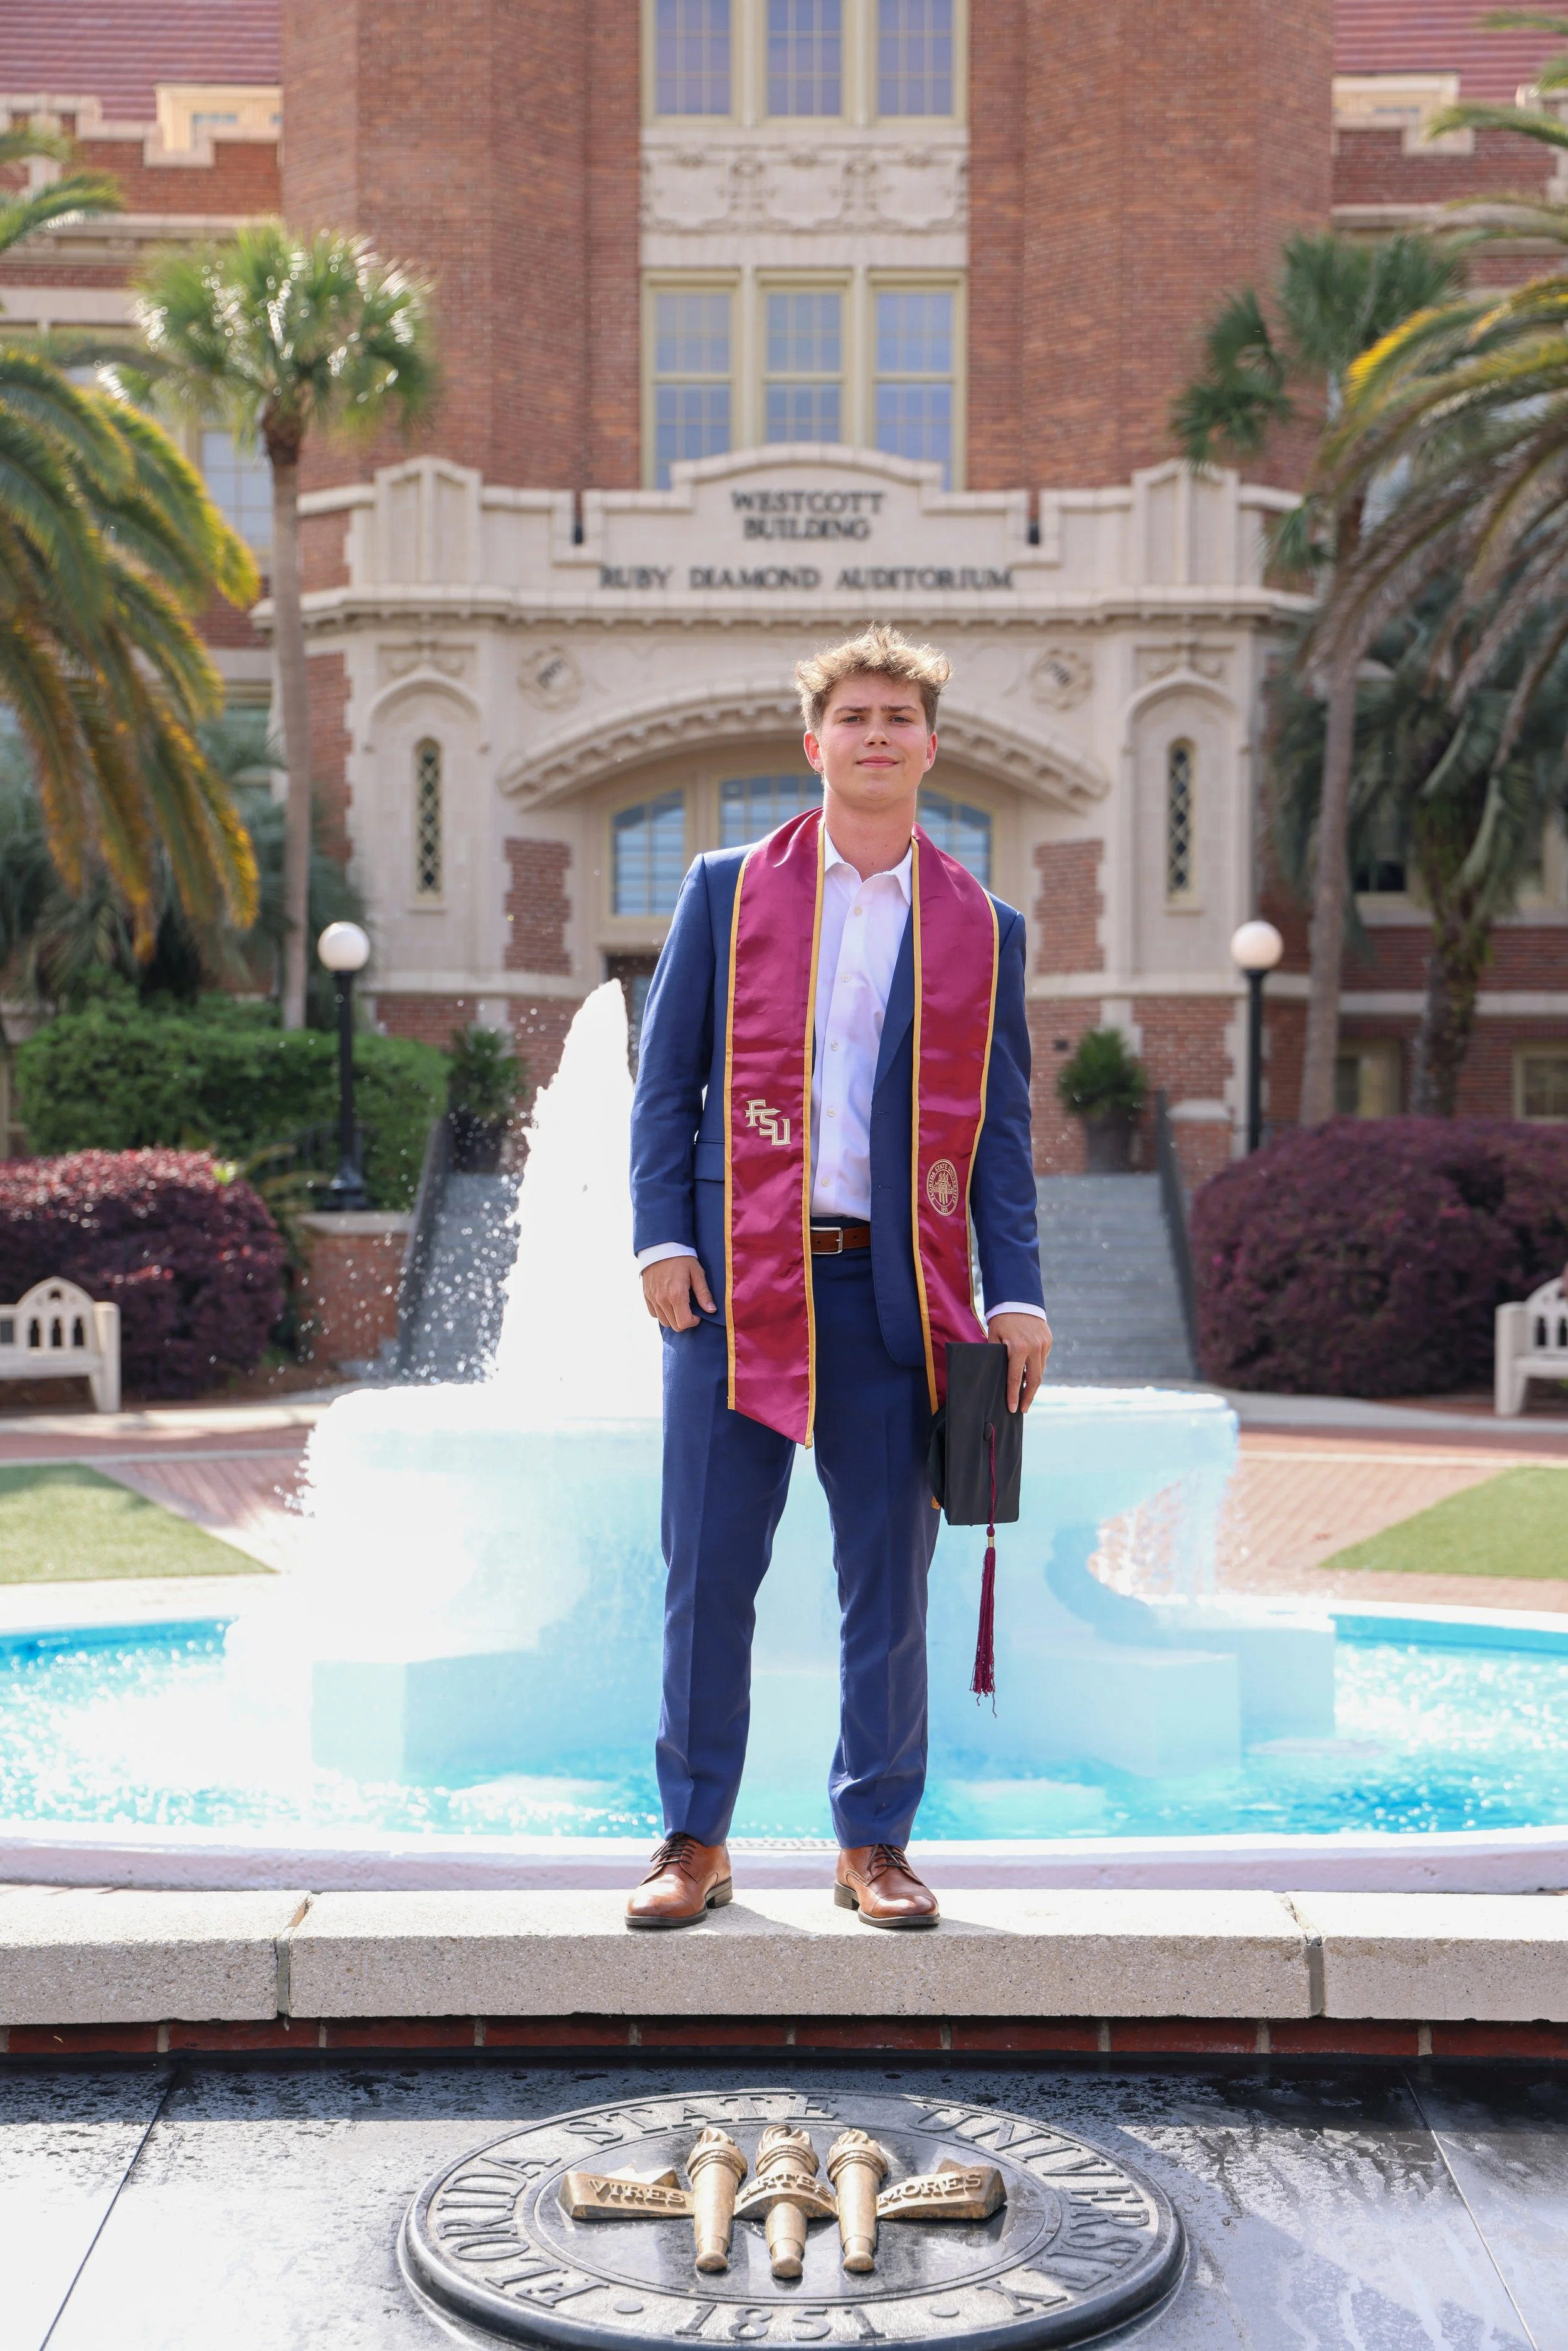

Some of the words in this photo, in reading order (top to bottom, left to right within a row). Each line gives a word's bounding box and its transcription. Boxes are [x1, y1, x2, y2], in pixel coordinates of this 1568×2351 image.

[731, 491, 884, 513] WESTCOTT
[744, 518, 870, 541] BUILDING
[600, 565, 672, 589] RUBY
[691, 565, 820, 589] DIAMOND
[836, 565, 1013, 589] AUDITORIUM
[744, 1100, 791, 1145] FSU
[935, 1164, 948, 1172] STATE
[588, 2179, 687, 2205] VIRES
[740, 2172, 830, 2204] ARTES
[878, 2172, 983, 2207] MORES
[437, 2157, 608, 2307] FLORIDA
[563, 2095, 839, 2144] STATE
[906, 2106, 1149, 2316] UNIVERSITY
[674, 2303, 886, 2339] 1851
